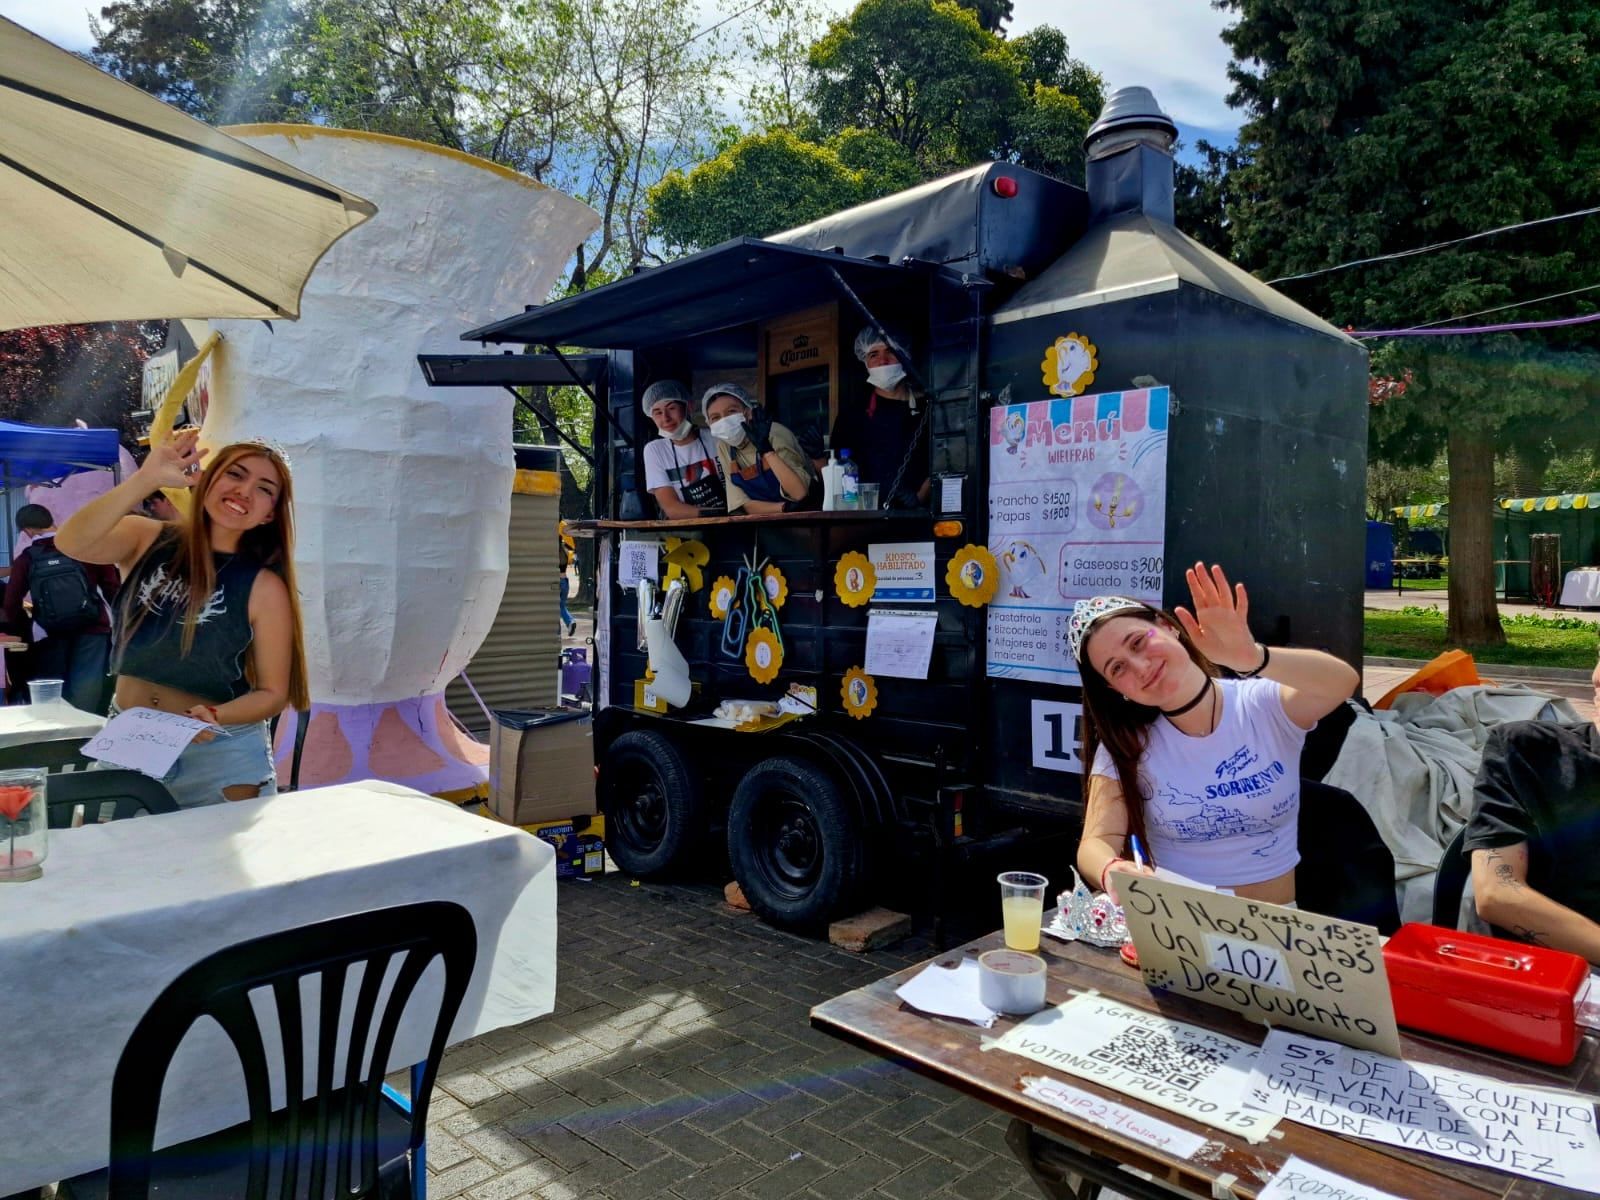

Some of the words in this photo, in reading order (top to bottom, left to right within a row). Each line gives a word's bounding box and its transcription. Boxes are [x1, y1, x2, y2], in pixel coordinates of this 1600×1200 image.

[1025, 411, 1121, 448] Menú
[997, 494, 1039, 507] Pancho
[996, 511, 1031, 524] Papas
[876, 560, 926, 571] HABILITADO
[885, 552, 917, 561] KIOSCO
[1073, 558, 1129, 571] Gaseosa
[1072, 574, 1122, 587] Licuado
[994, 624, 1048, 637] Bizcochuelo
[994, 637, 1034, 650] Alfajores
[1036, 640, 1047, 650] de
[994, 650, 1036, 662] maicena
[1204, 760, 1285, 800] SORRENTO
[1246, 788, 1272, 799] ITALY
[1127, 879, 1174, 920] Si
[1183, 900, 1260, 942] Nos
[1261, 921, 1376, 974] Votas
[1247, 904, 1315, 932] Puesto
[1322, 924, 1348, 941] 15
[1150, 922, 1198, 957] Un
[1302, 960, 1345, 993] de
[1178, 955, 1378, 1036] Descuento
[1201, 1035, 1242, 1053] POR
[1284, 1043, 1336, 1067] 5%
[1350, 1056, 1398, 1084] DE
[1407, 1068, 1593, 1124] DESCUENTO
[1126, 1075, 1219, 1113] PUESTO
[1225, 1110, 1257, 1129] 15
[1266, 1073, 1424, 1127] UNIFORME
[1437, 1115, 1471, 1136] DE
[1484, 1124, 1524, 1147] LA
[1279, 1061, 1325, 1087] SI
[1338, 1075, 1451, 1113] VENIS
[1462, 1104, 1519, 1128] CON
[1537, 1118, 1576, 1138] EL
[1284, 1099, 1384, 1138] PADRE
[1397, 1125, 1567, 1179] VASQUEZ
